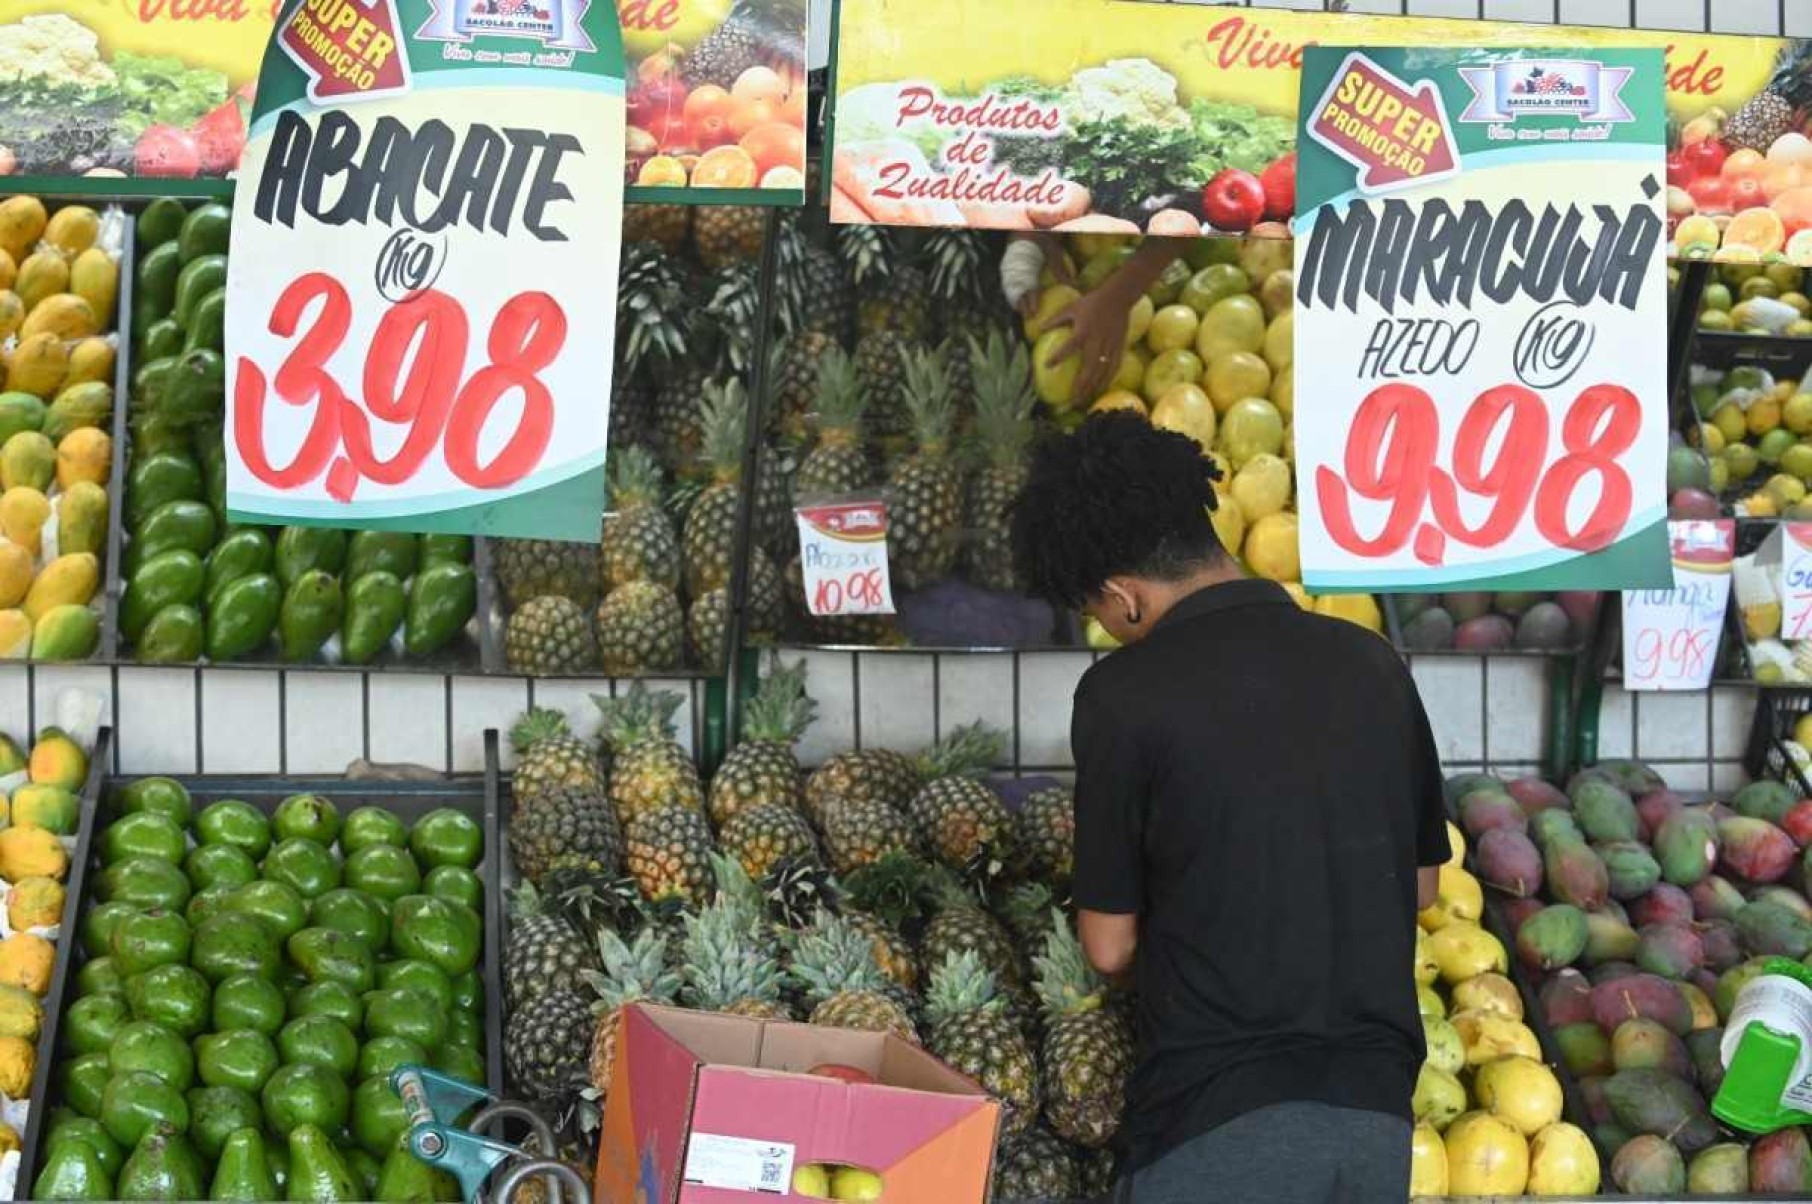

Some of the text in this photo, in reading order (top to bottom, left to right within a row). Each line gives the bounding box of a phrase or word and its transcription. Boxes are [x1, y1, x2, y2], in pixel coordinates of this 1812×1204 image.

[308, 0, 395, 69] UPER
[517, 20, 554, 31] CENTER
[620, 0, 679, 32] de
[291, 9, 375, 90] PROMOÇÃO
[1665, 44, 1724, 96] de
[895, 86, 1061, 132] Produtos
[1336, 71, 1442, 155] SUPER
[1554, 98, 1589, 106] CENTER
[945, 131, 988, 165] de
[1322, 102, 1426, 176] PROMOÇÃO
[253, 108, 586, 242] ABACATE
[872, 161, 1065, 206] Qualidade
[1297, 173, 1664, 312] MARACUJÁ
[1357, 318, 1481, 379] AZEDO
